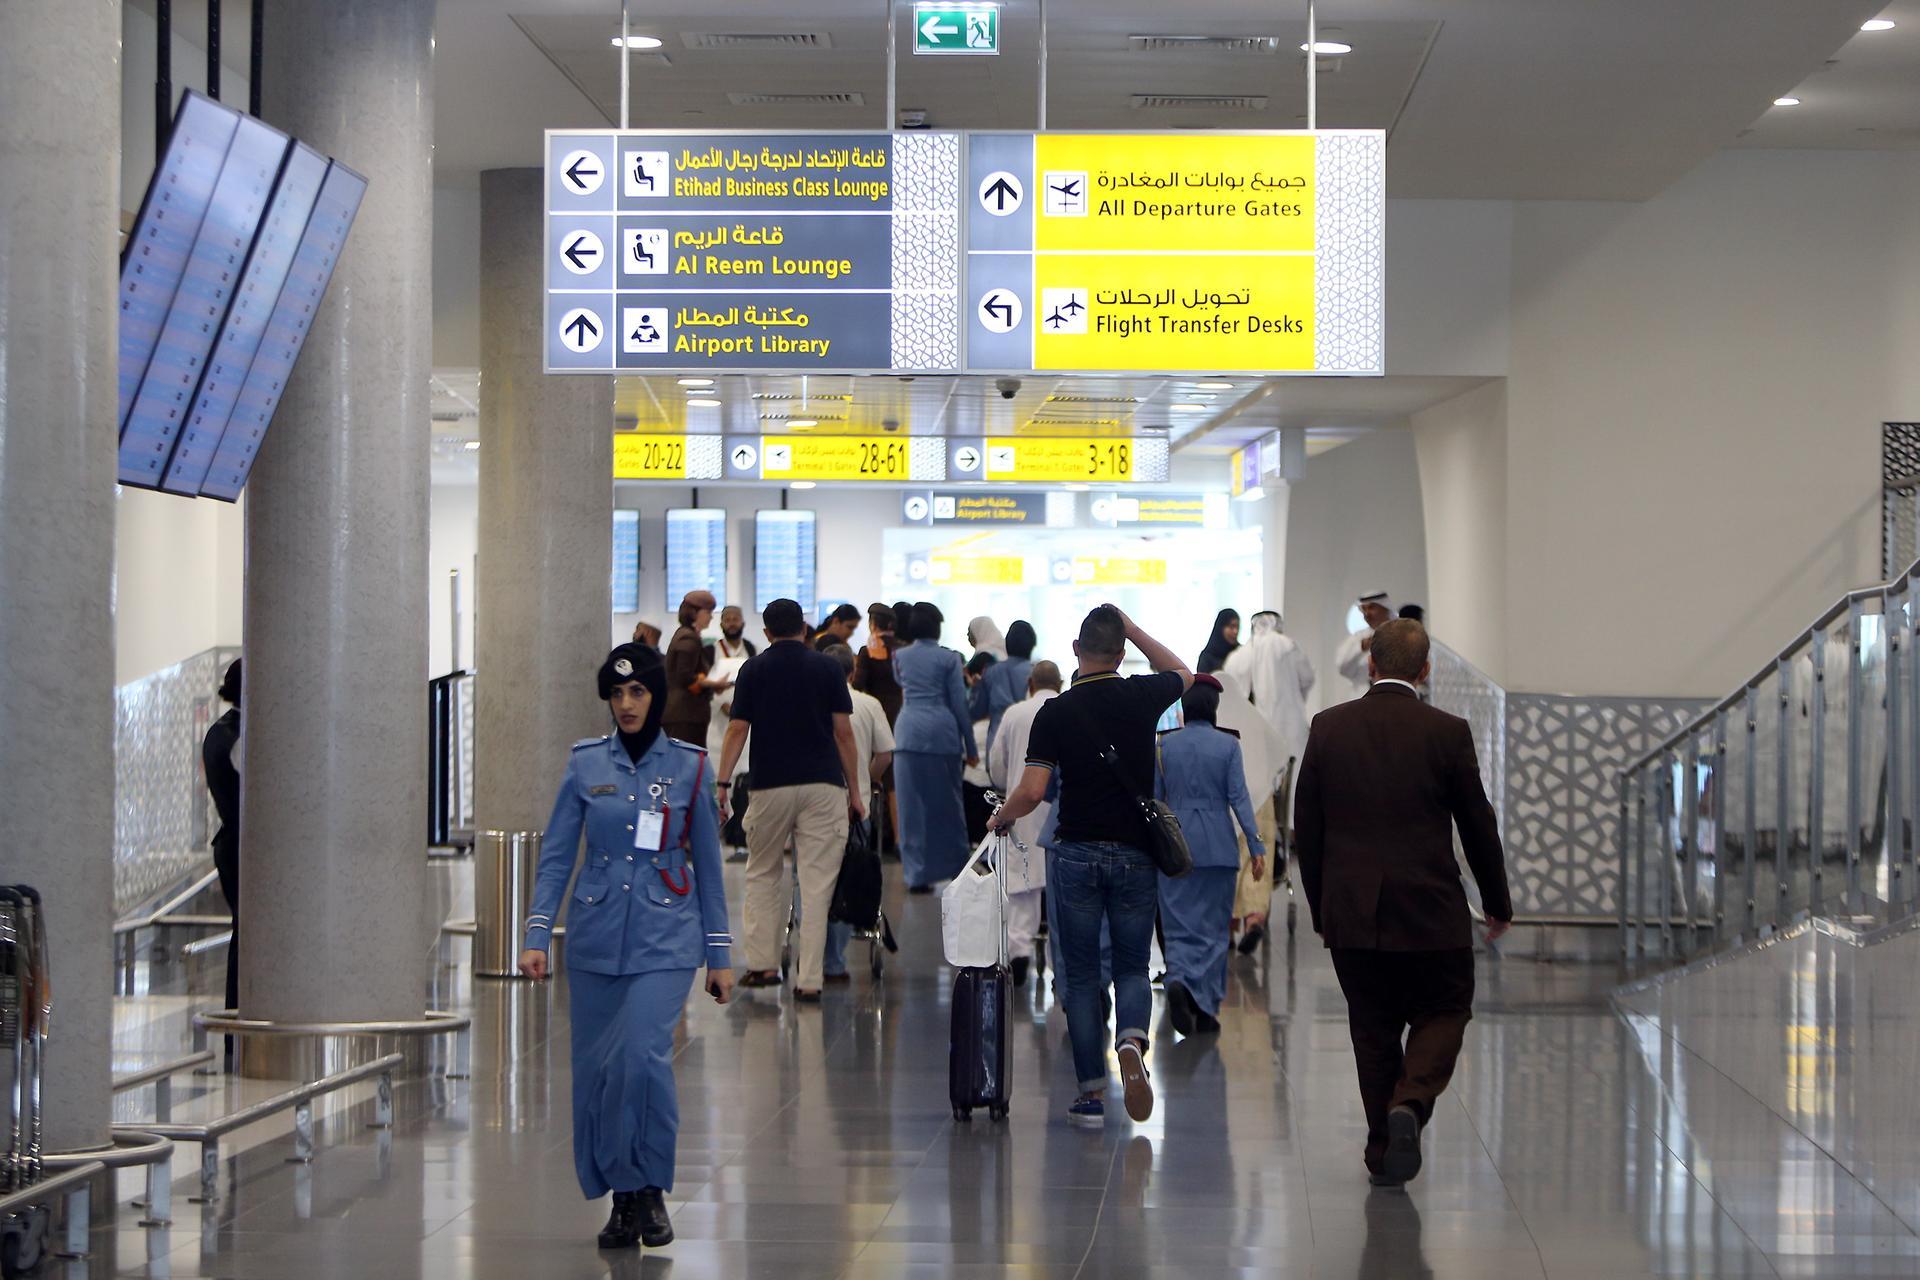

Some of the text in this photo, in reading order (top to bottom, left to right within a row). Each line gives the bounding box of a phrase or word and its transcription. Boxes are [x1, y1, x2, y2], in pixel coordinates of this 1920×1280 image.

[675, 147, 887, 172] قاعة الإتحاد لدرجة رجال الأعمال
[675, 177, 889, 201] Etihad Business Class Lounge
[1097, 171, 1306, 192] جميع بوابات المغادرة
[1098, 199, 1302, 220] All Departure Gates
[674, 224, 785, 250] قاعة الريم
[674, 255, 852, 279] Al Reem Lounge
[1096, 288, 1250, 310] تحويل الرحلات
[674, 306, 809, 328] مكتبة المطار
[1097, 314, 1304, 337] Flight Transfer Desks
[674, 335, 831, 357] Airport Library
[644, 442, 682, 469] 20-22
[860, 442, 905, 473] 28-61
[1088, 444, 1129, 474] 3-18
[956, 509, 1027, 521] Airport Library
